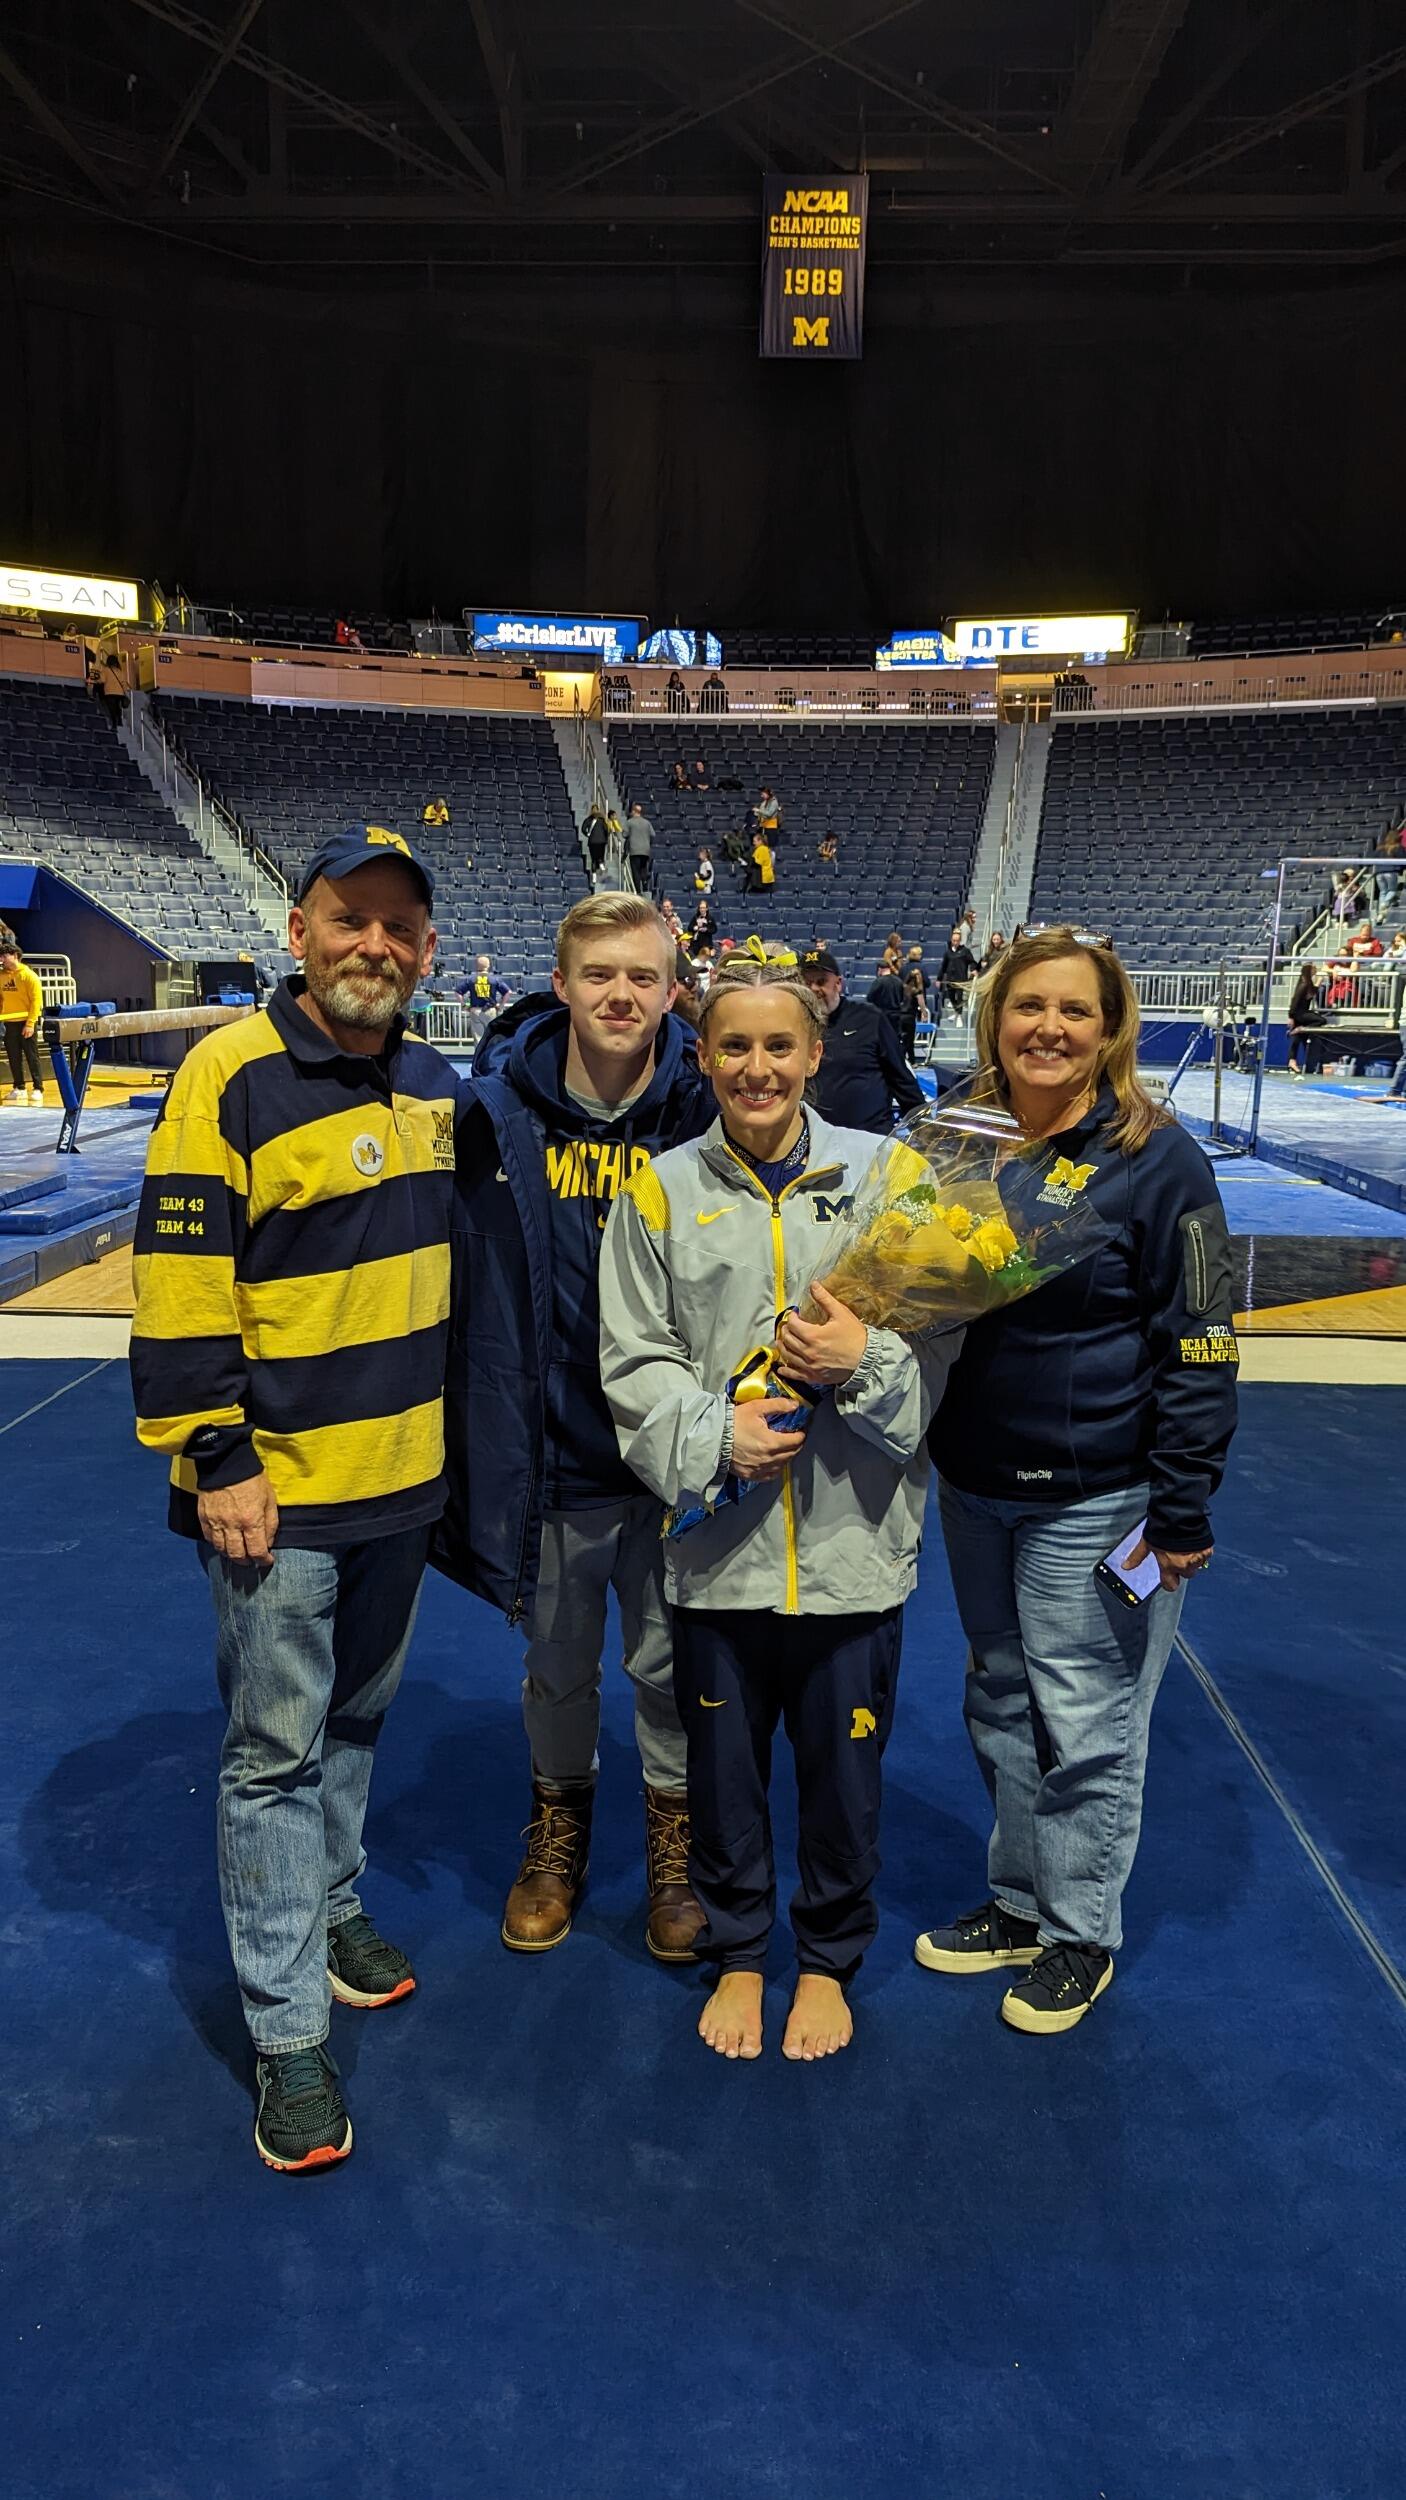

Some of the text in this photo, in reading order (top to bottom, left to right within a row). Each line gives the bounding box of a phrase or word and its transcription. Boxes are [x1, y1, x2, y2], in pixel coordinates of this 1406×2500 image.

[783, 190, 848, 213] NCAA
[770, 215, 861, 235] CHAMPIONS
[769, 236, 860, 249] MEN'S BASKETBALL
[784, 268, 843, 296] 1989
[792, 316, 830, 347] M
[8, 578, 126, 610] SSAN
[972, 625, 1040, 649] DTE
[366, 826, 412, 858] M
[805, 951, 819, 963] M
[1044, 1155, 1100, 1192] M
[159, 1197, 205, 1212] TEAM 43
[811, 1195, 859, 1223] M
[156, 1220, 204, 1235] TEAM 44
[1206, 1325, 1231, 1338] 2021
[1180, 1338, 1209, 1351] NCAA
